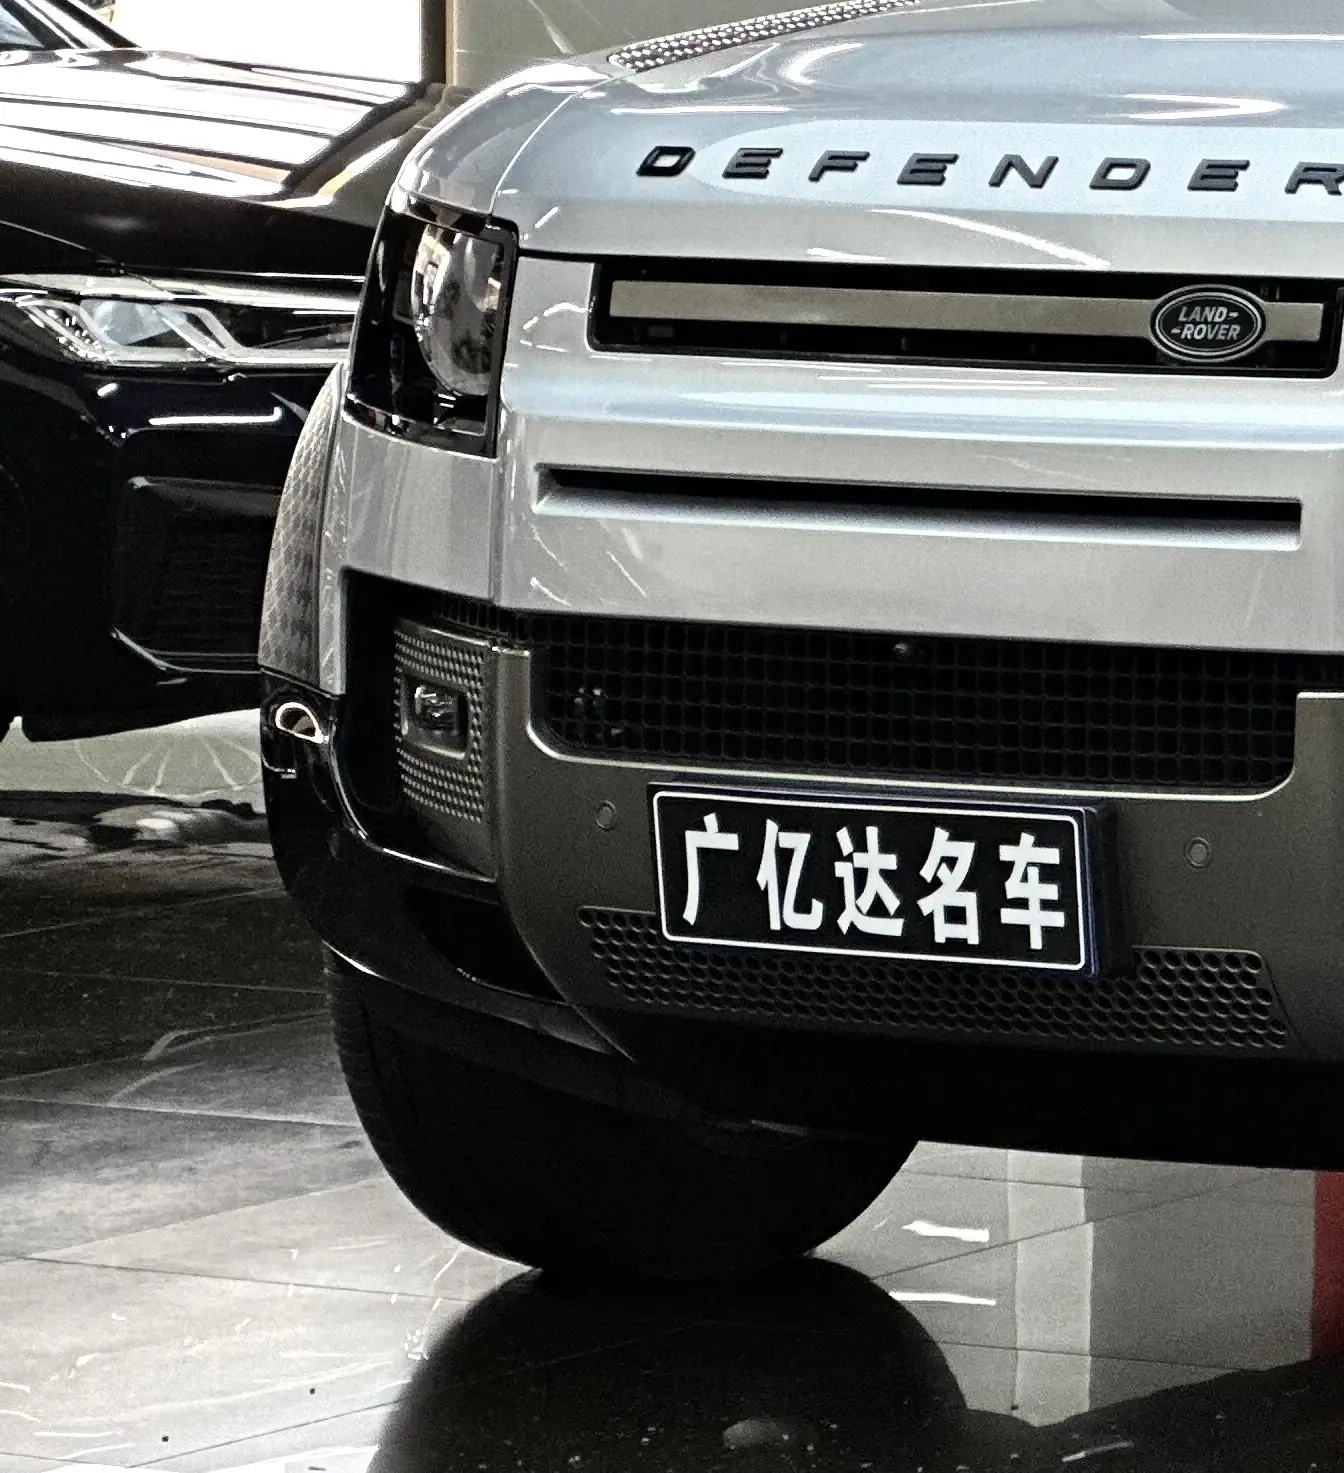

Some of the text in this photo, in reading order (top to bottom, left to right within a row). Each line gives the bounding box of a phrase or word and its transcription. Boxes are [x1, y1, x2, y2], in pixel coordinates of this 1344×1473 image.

[682, 812, 1066, 950] 广亿达名车
